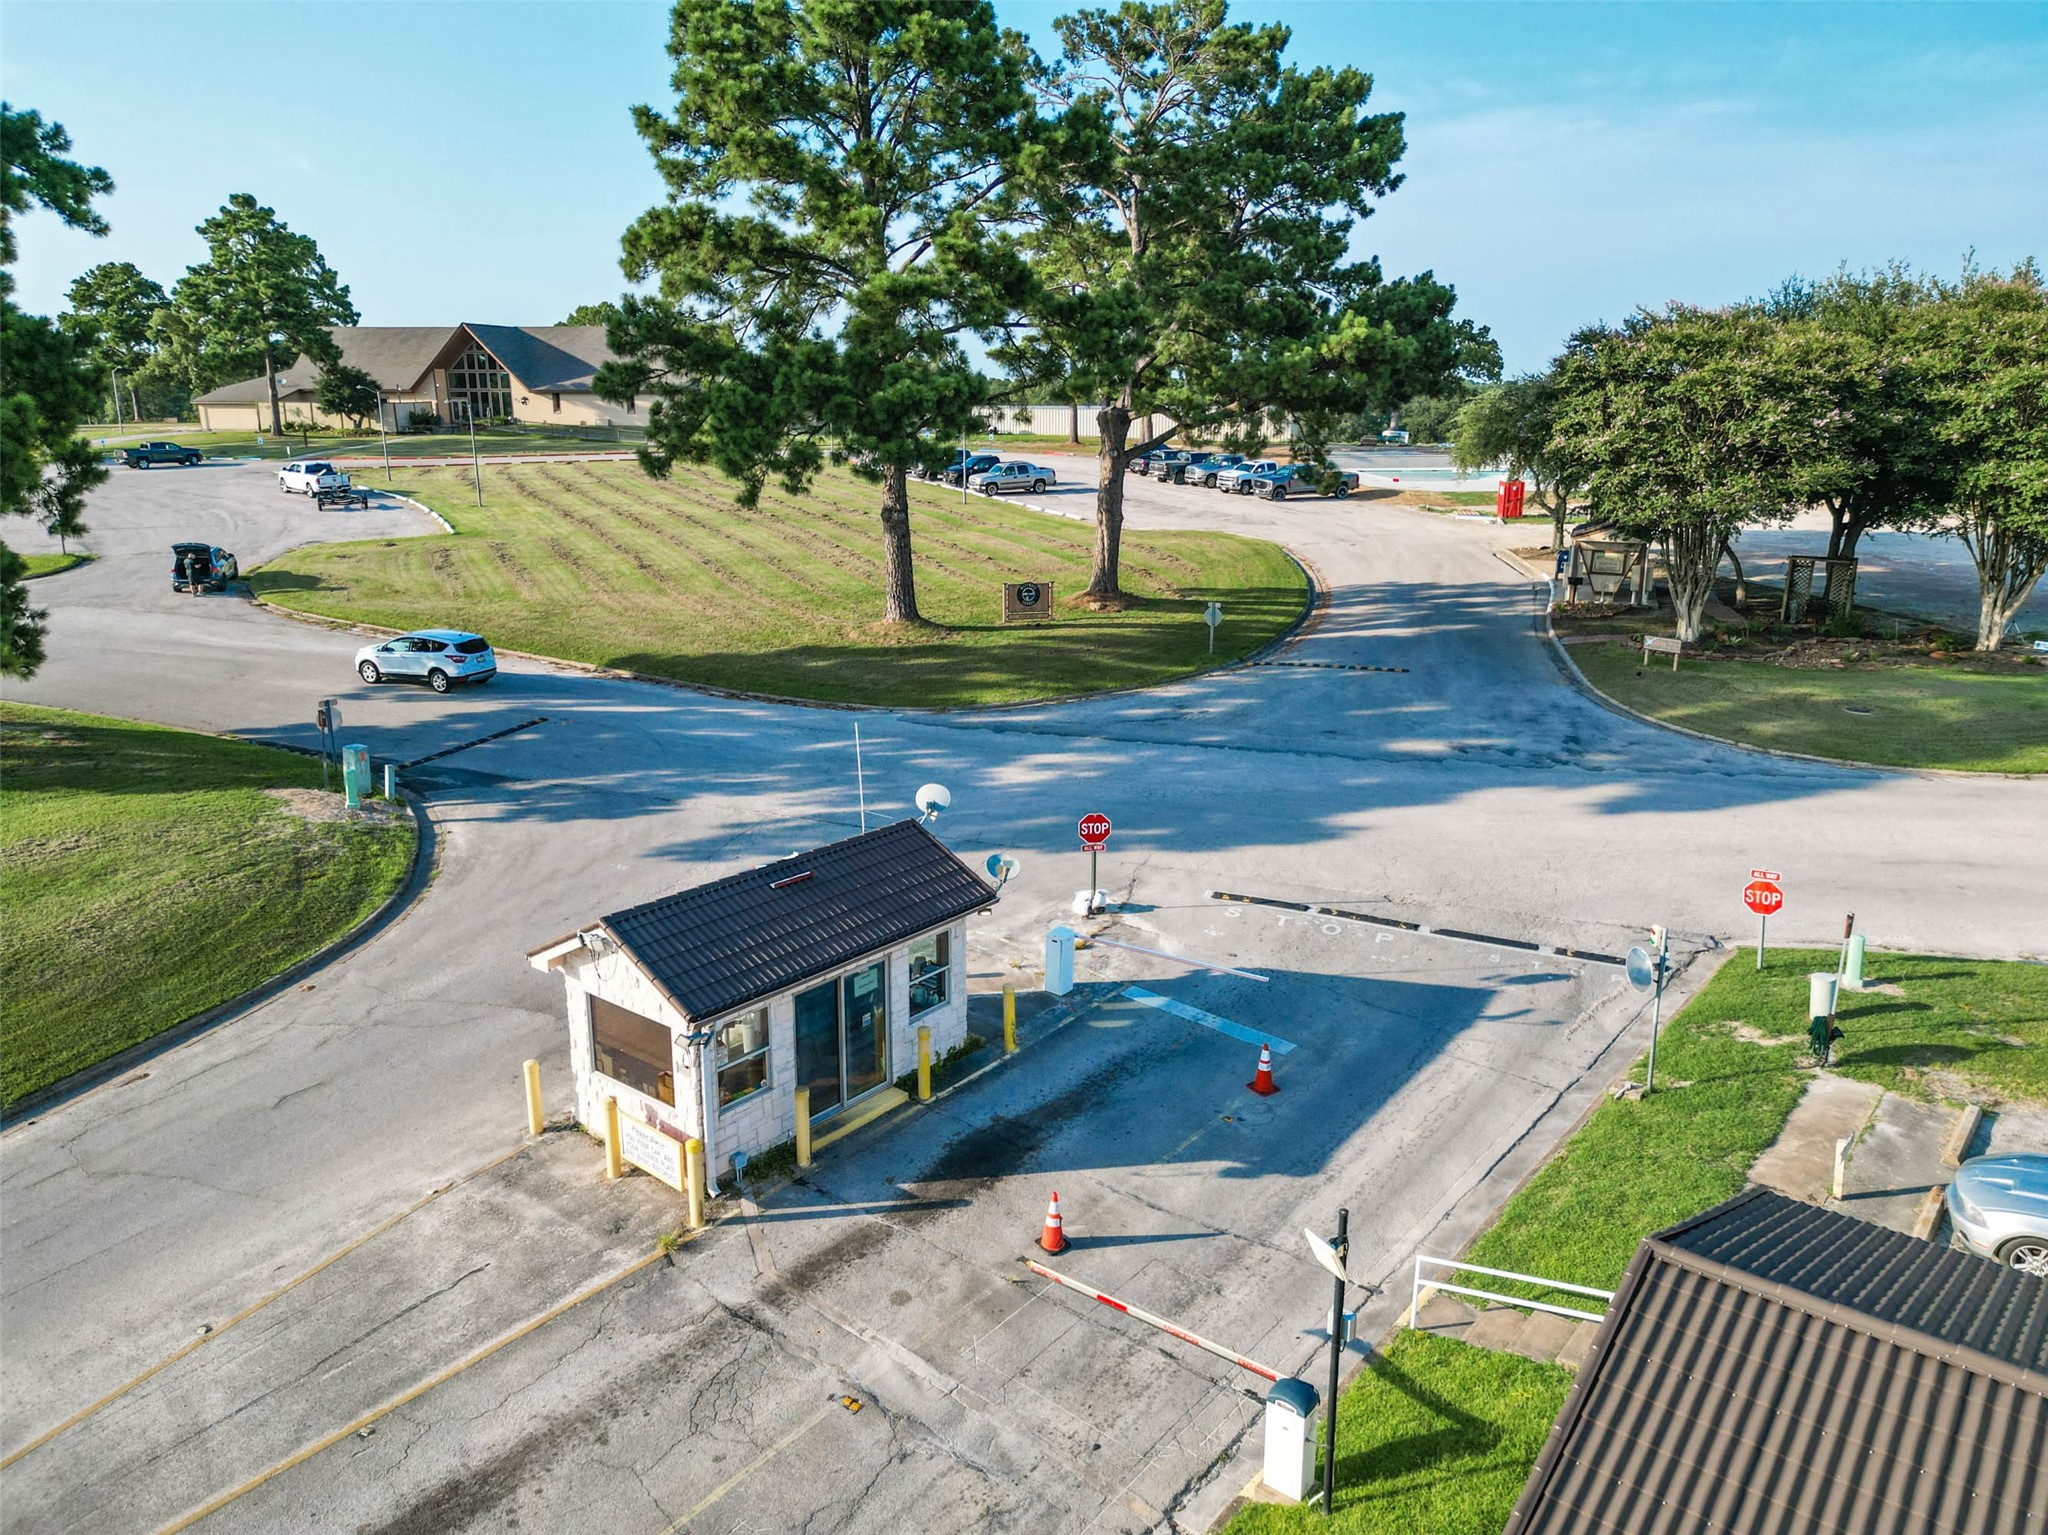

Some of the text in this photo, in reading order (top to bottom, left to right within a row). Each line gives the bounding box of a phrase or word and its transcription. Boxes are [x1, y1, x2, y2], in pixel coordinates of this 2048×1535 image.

[1081, 823, 1109, 835] STOP
[1745, 889, 1781, 906] STOP
[1225, 906, 1394, 944] STOP
